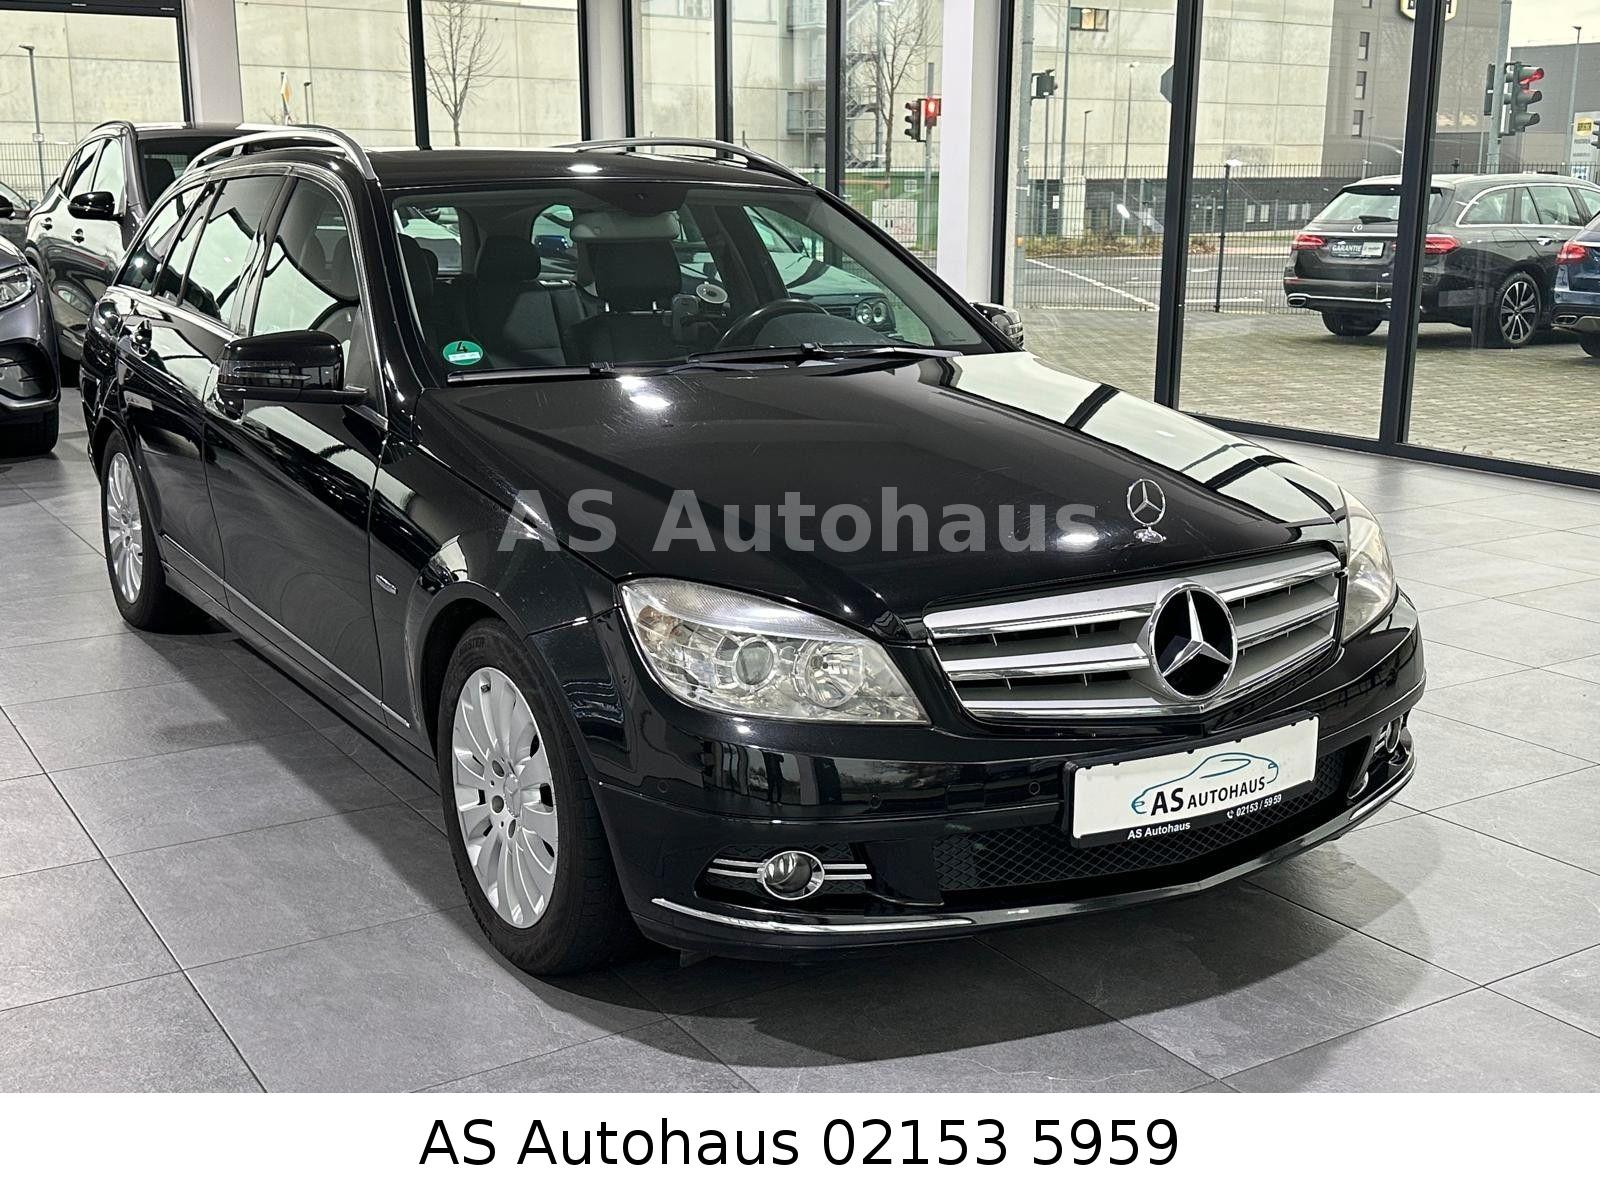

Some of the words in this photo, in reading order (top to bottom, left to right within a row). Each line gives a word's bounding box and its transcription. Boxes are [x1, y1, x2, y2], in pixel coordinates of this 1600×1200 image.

[1332, 244, 1361, 252] GARANTIE
[456, 341, 468, 352] 4
[1150, 787, 1184, 816] AS
[1187, 776, 1265, 809] AUTOHAUS
[1236, 801, 1259, 817] 02153
[1127, 828, 1143, 840] AS
[1144, 822, 1191, 838] Autohaus
